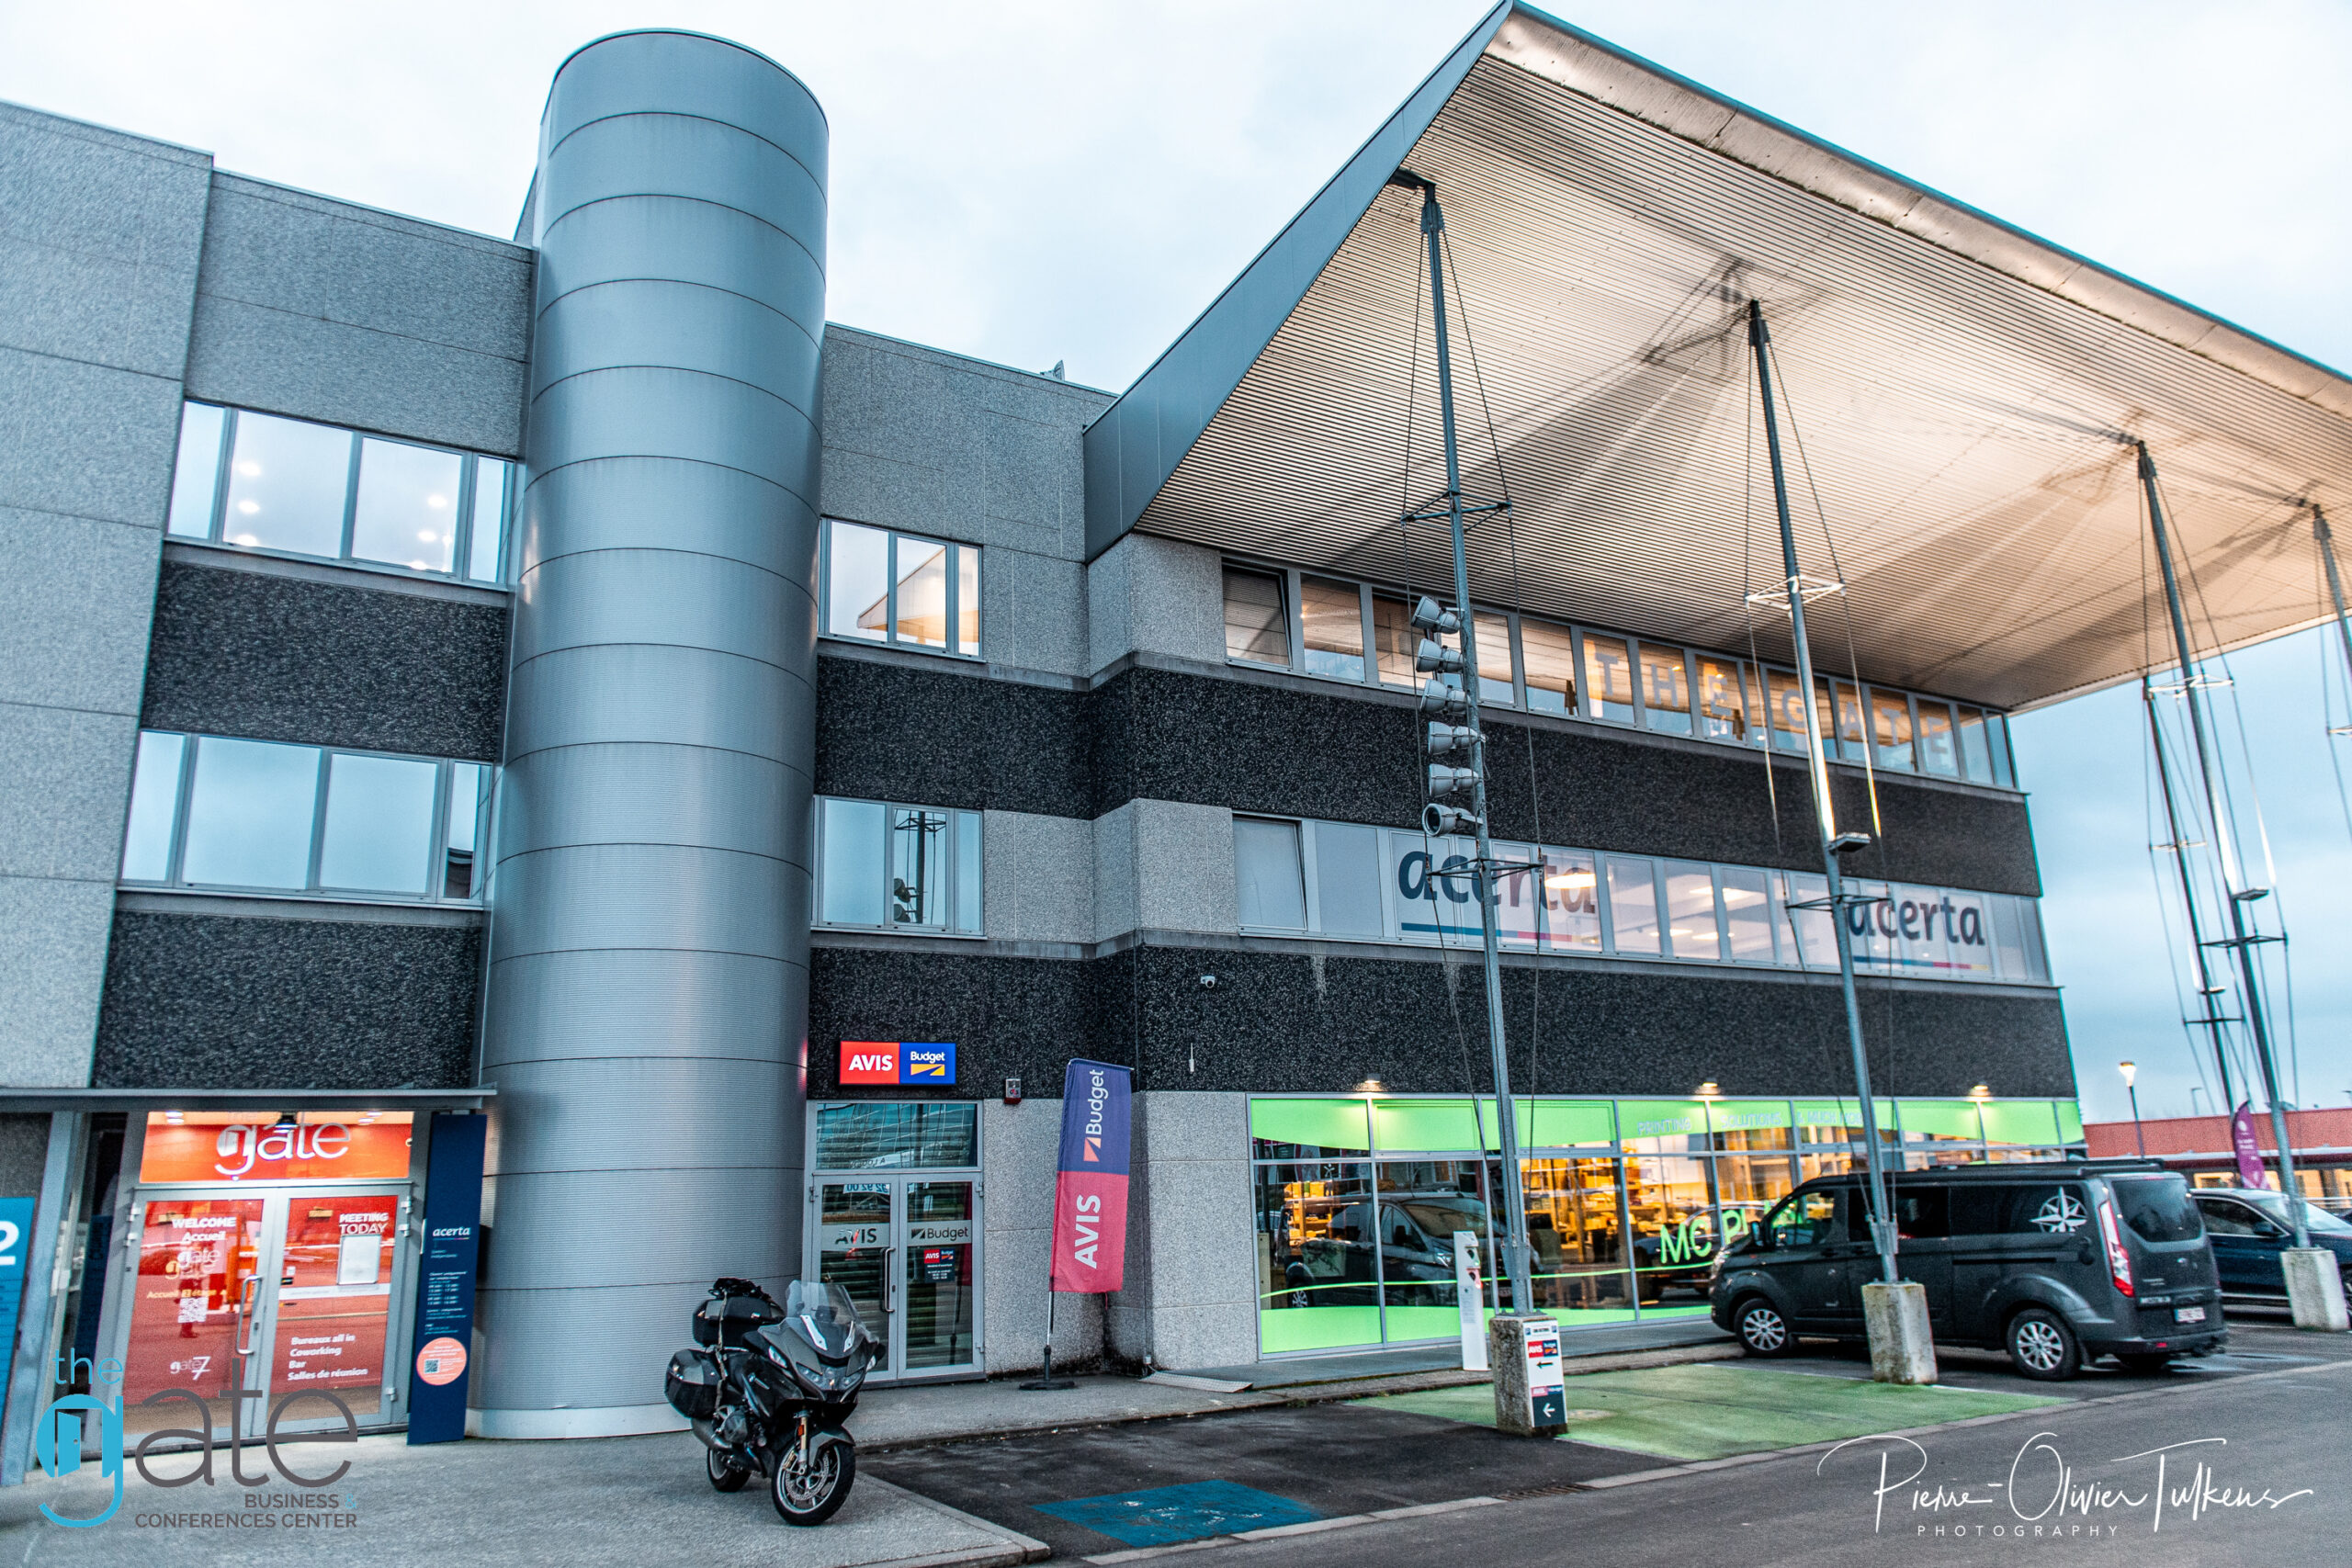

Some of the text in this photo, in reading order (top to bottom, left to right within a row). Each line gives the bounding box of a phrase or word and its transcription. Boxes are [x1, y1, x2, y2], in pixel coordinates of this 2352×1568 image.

[1594, 652, 1949, 754] THE GATE
[1397, 851, 1596, 914] acerta
[1848, 897, 1985, 946] acerta
[848, 1054, 893, 1071] AVIS
[910, 1051, 945, 1064] Budget
[1085, 1069, 1109, 1135] Budget
[1637, 1117, 1691, 1135] PRINTING
[1720, 1111, 1782, 1129] SOLUTIONS
[215, 1112, 351, 1176] gate
[171, 1217, 237, 1228] WELCOME
[339, 1213, 390, 1224] MEETING
[339, 1223, 389, 1235] TODAY
[432, 1226, 471, 1237] acerta
[928, 1227, 968, 1241] Budget
[1074, 1194, 1102, 1270] AVIS
[181, 1231, 226, 1244] Accueil
[835, 1228, 877, 1245] AVIS
[1660, 1219, 1713, 1263] MC
[291, 1334, 356, 1346] Bureaux all in
[289, 1346, 342, 1358] Coworking
[288, 1360, 306, 1369] Bar
[288, 1371, 316, 1381] Salles
[317, 1370, 330, 1379] de
